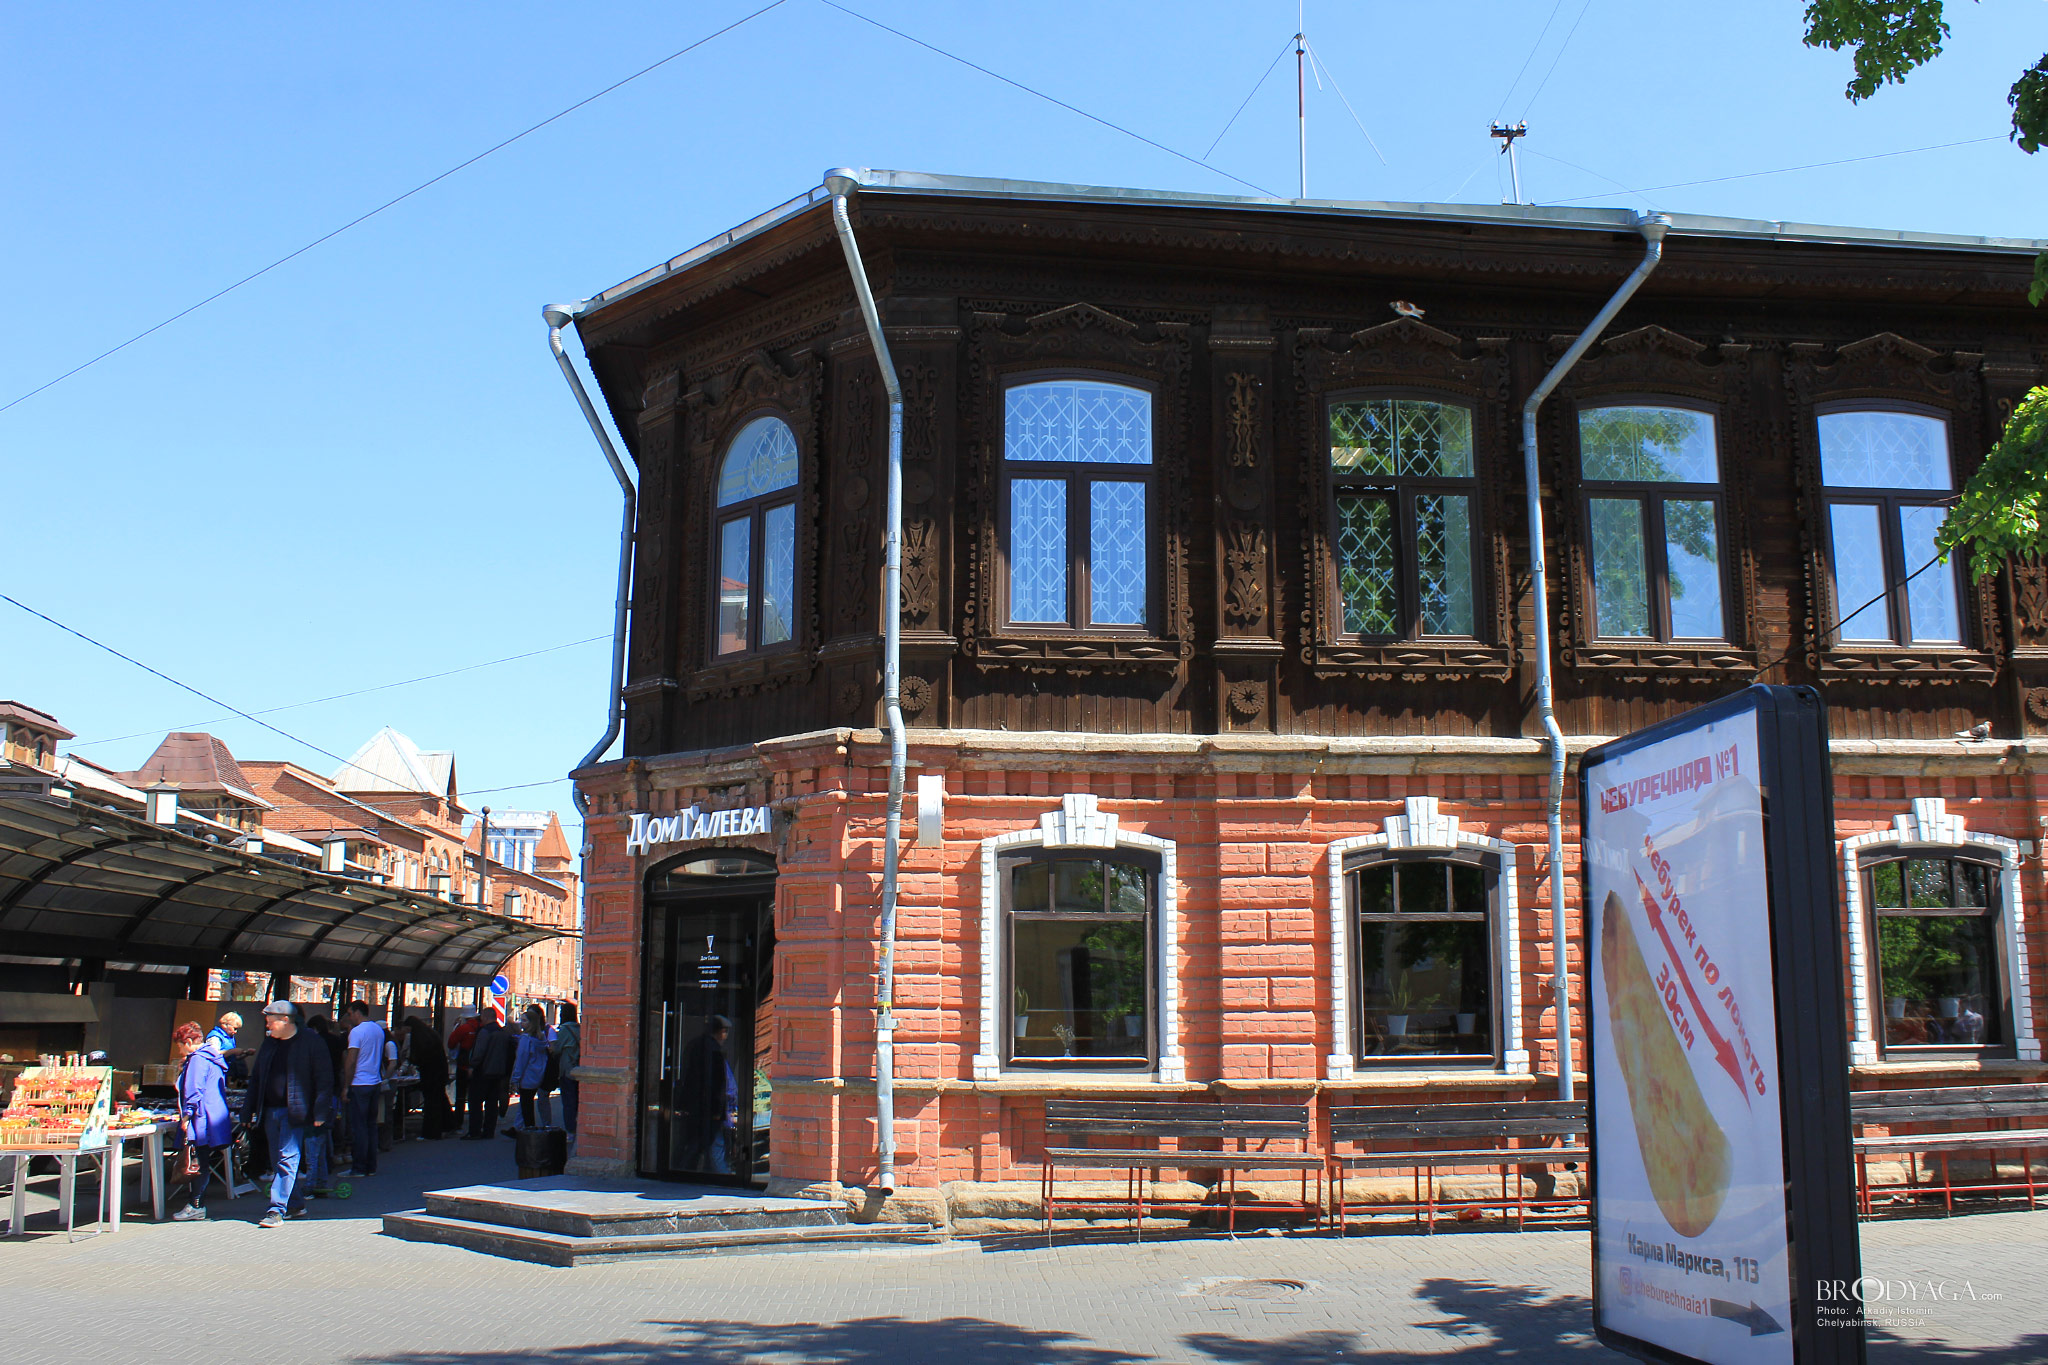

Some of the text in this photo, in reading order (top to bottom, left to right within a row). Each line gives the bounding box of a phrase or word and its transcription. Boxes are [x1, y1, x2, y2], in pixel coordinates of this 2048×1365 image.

[1600, 743, 1740, 814] ЧЕБУРЕЧНАЯ №1
[1644, 834, 1697, 948] чебурек
[1694, 944, 1720, 986] по
[1628, 1232, 1760, 1285] Карла Маркса, 113
